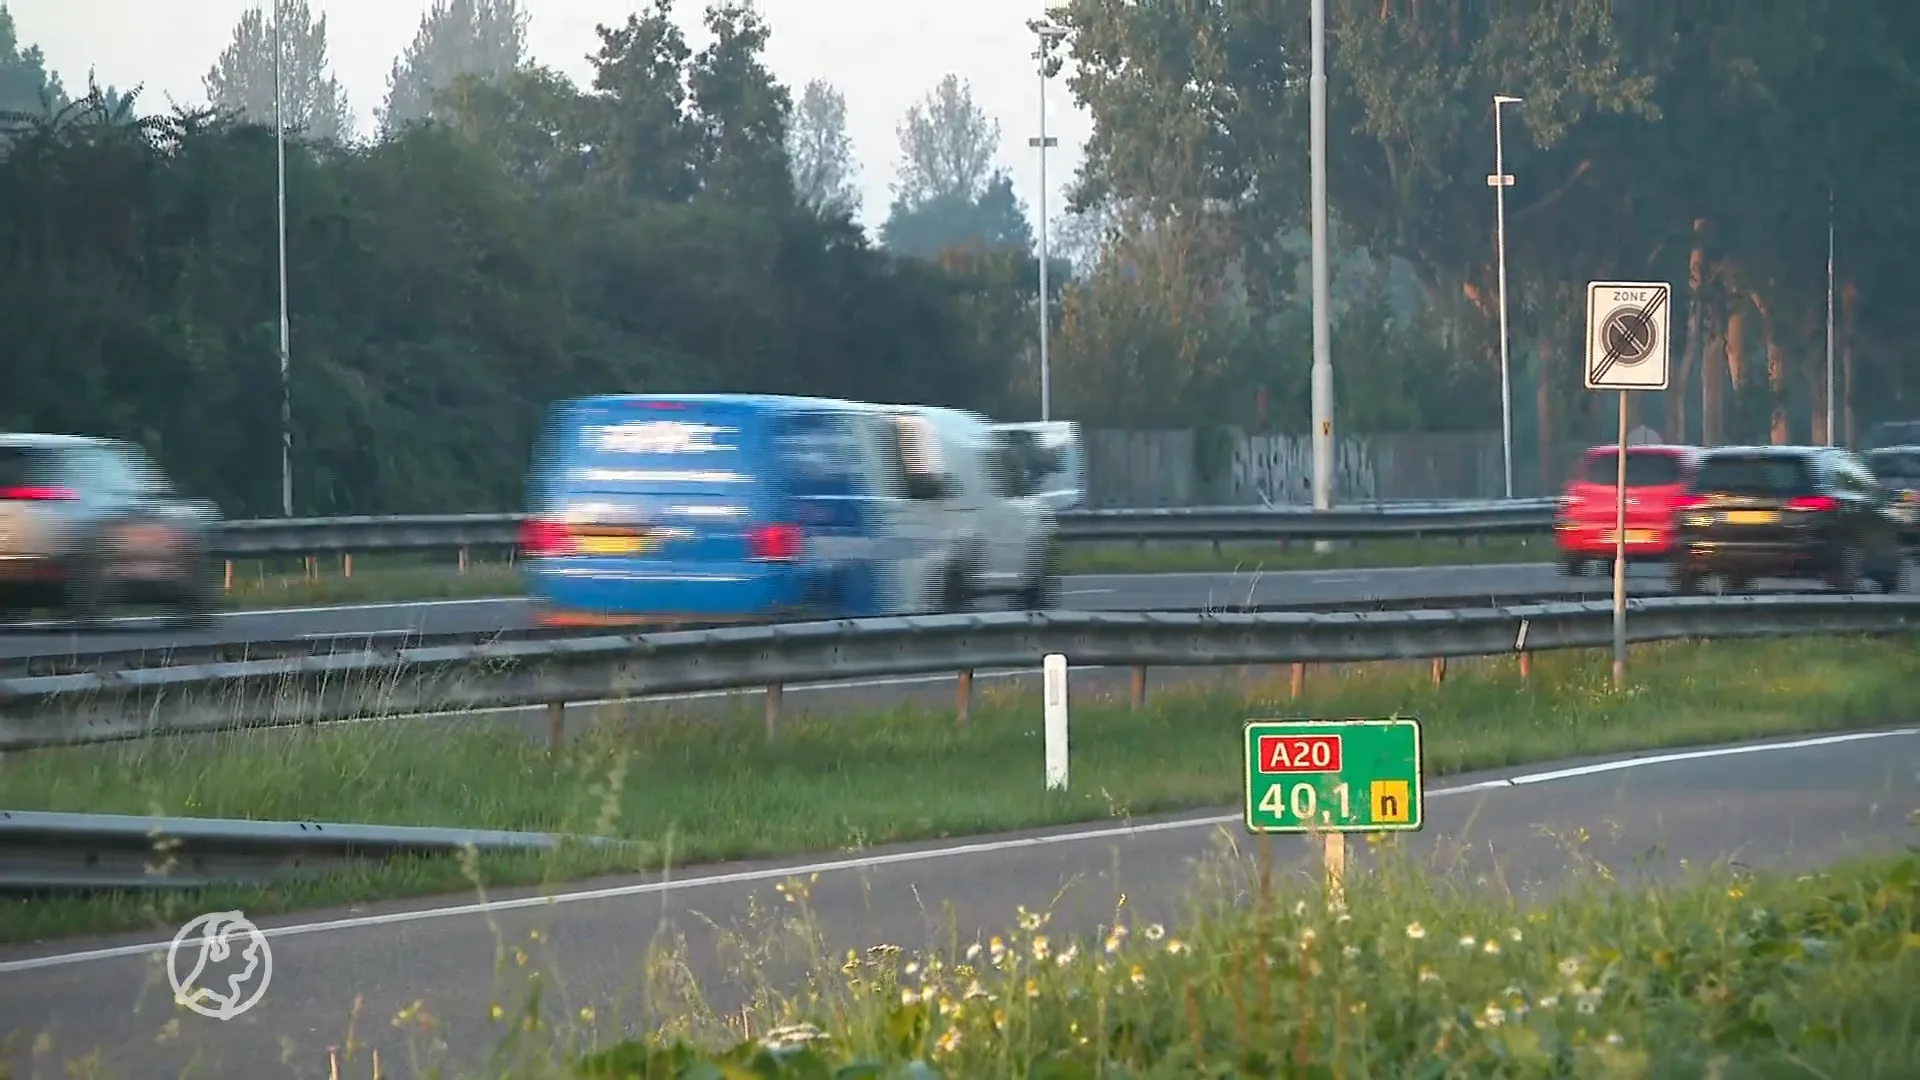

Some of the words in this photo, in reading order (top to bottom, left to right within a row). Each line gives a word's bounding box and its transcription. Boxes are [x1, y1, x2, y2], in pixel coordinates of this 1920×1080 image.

[1613, 291, 1647, 302] ZONE
[1270, 741, 1331, 767] A20
[1258, 782, 1349, 824] 40,1
[1380, 795, 1398, 816] n
